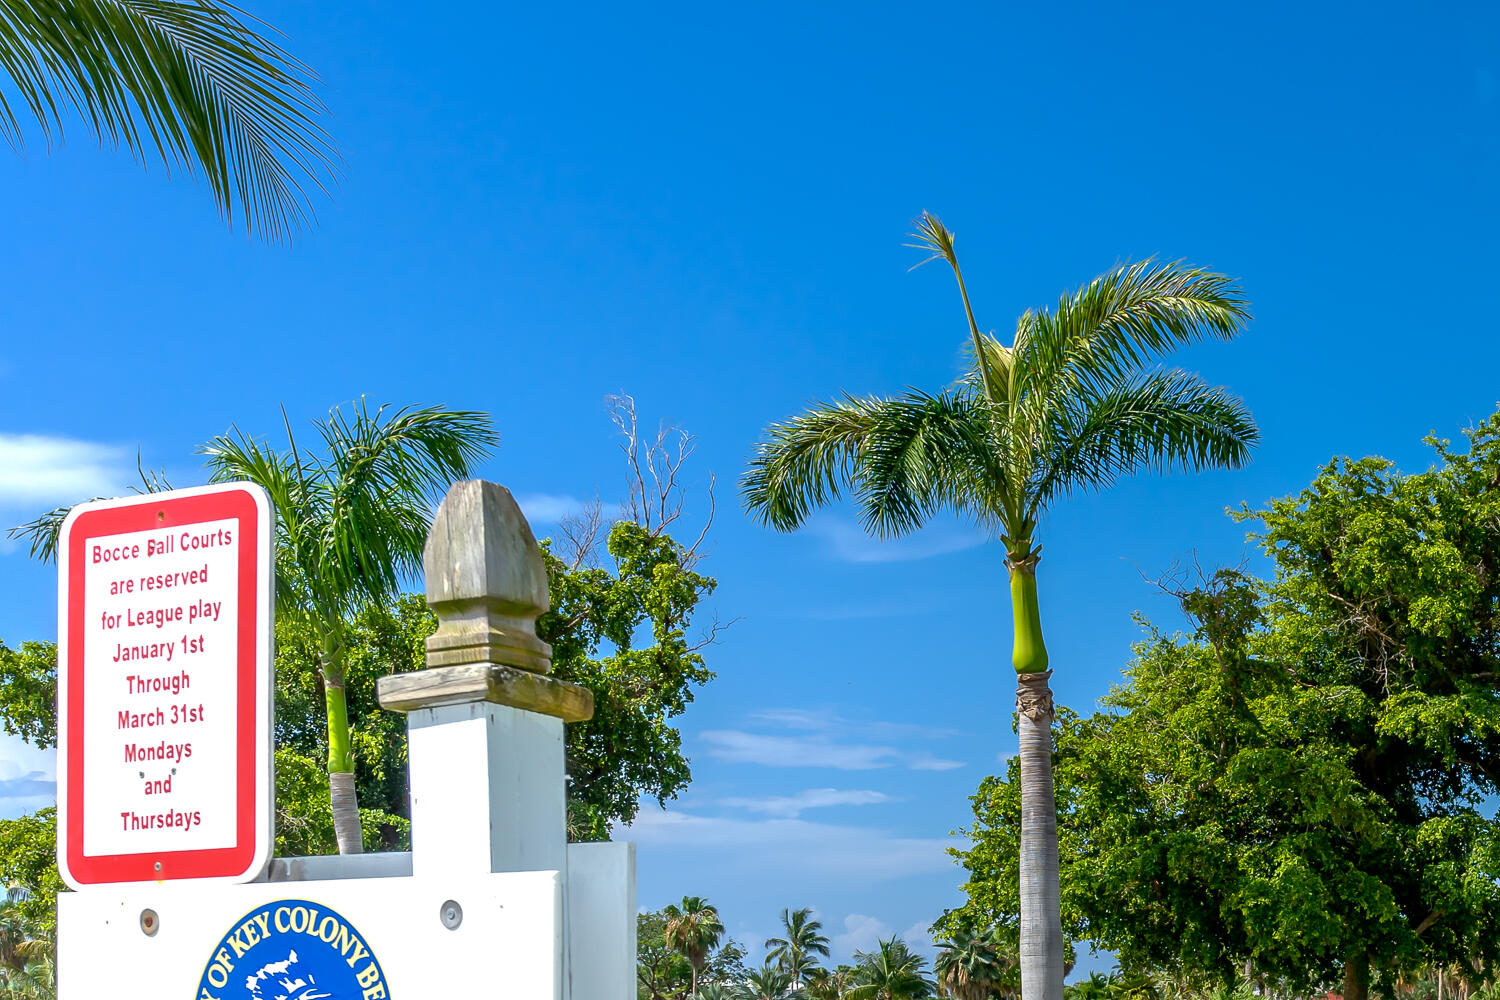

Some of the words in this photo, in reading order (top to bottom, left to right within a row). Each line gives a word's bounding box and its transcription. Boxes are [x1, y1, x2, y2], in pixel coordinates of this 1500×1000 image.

[92, 544, 140, 565] Bocce
[146, 534, 174, 557] Ball
[179, 528, 232, 552] Courts
[109, 578, 135, 596] are
[139, 563, 208, 592] reserved
[101, 611, 122, 630] for
[127, 606, 184, 629] League
[188, 599, 222, 625] play
[112, 642, 175, 663] January
[180, 634, 205, 654] 1st
[125, 669, 190, 696] Through
[117, 707, 165, 729] March
[170, 703, 204, 725] 31st
[124, 740, 192, 764] Mondays
[144, 775, 172, 796] and
[120, 808, 201, 832] Thursdays
[207, 947, 234, 988] OF
[227, 911, 271, 958] KEY
[274, 906, 370, 968] COLONY
